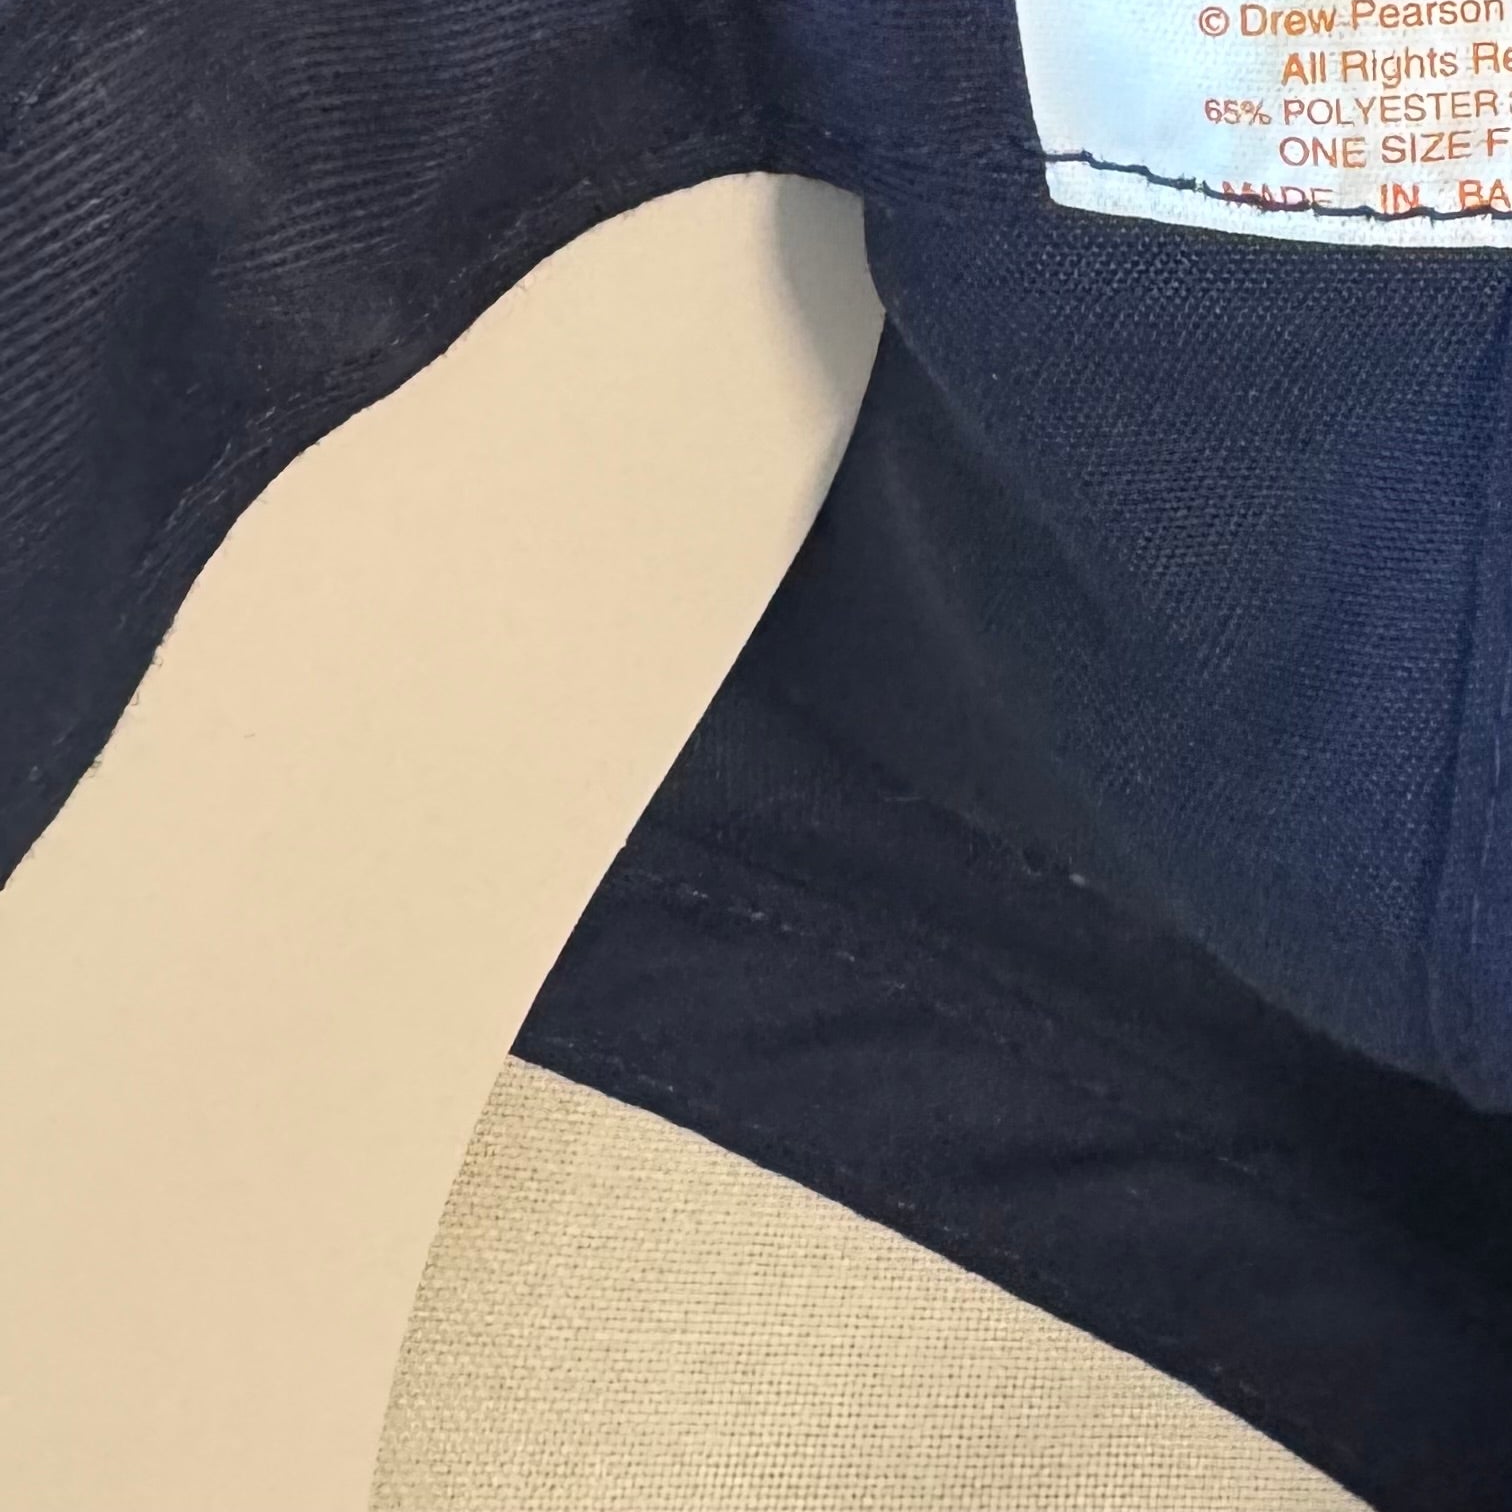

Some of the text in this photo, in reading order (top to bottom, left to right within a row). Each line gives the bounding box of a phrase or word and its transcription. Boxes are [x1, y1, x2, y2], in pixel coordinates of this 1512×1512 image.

[1240, 3, 1337, 37] Drew
[1281, 51, 1328, 86] All
[1341, 46, 1458, 89] Rights
[1204, 98, 1272, 126] 65%
[1283, 89, 1498, 126] POLYESTER
[1279, 136, 1367, 168] ONE
[1381, 130, 1473, 164] SIZE
[1379, 182, 1421, 215] IN
